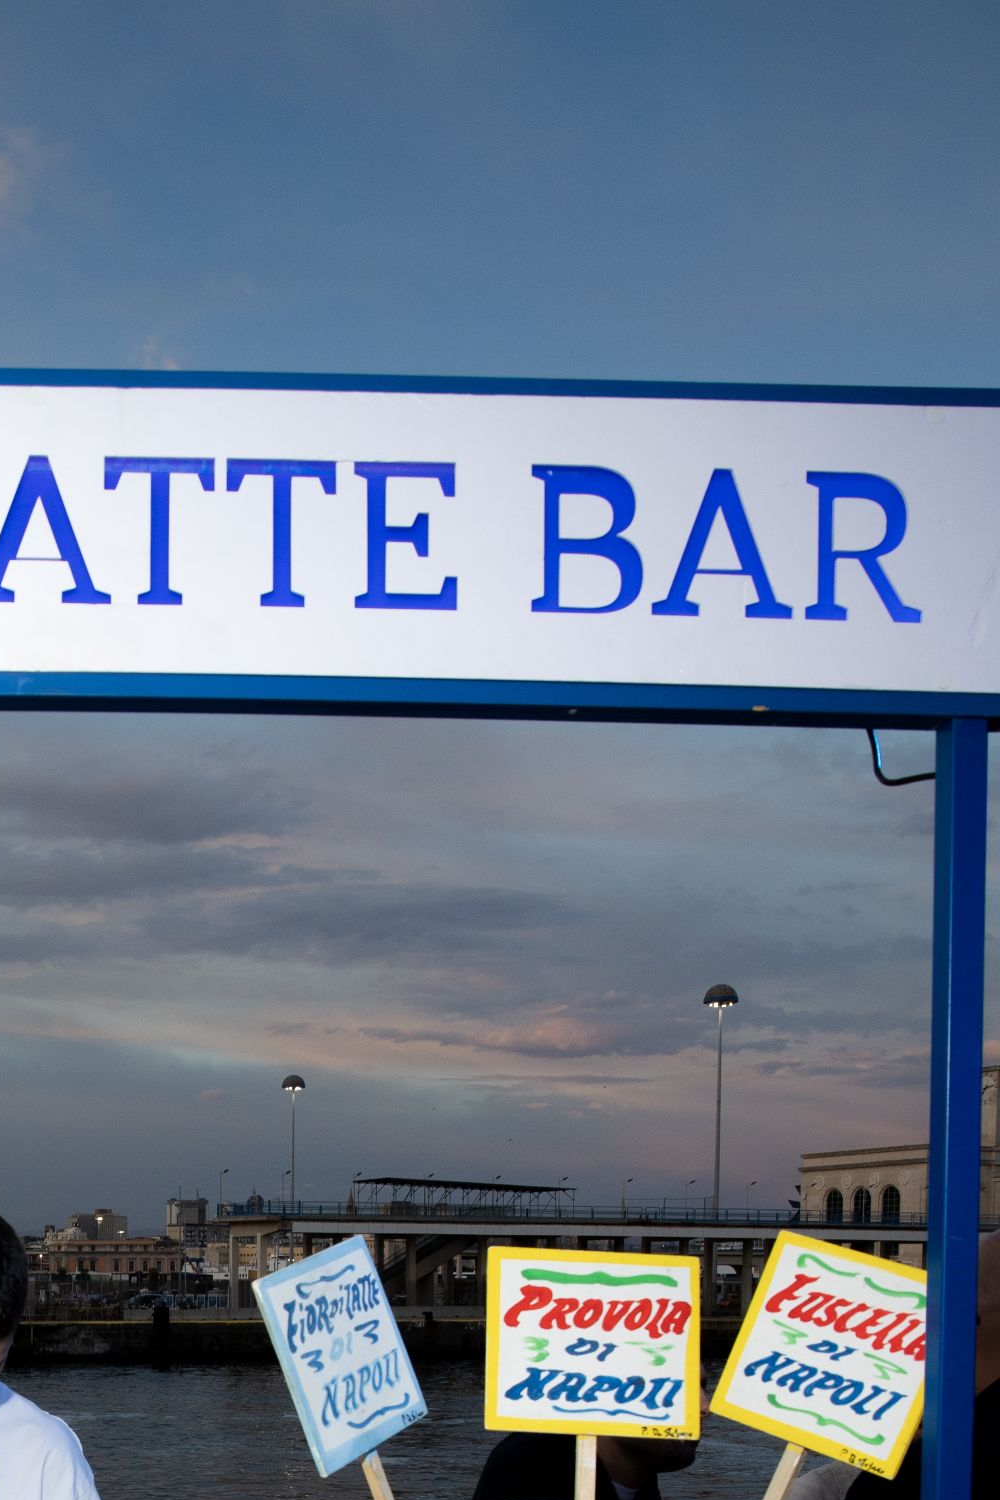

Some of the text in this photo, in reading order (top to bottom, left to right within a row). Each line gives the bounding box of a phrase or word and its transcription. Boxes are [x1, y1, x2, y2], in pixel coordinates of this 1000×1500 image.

[531, 463, 922, 623] BAR
[503, 1284, 692, 1339] PROVOLA
[329, 1331, 354, 1362] DI
[565, 1337, 619, 1362] DI
[806, 1339, 857, 1361] DI
[321, 1348, 401, 1427] NAPOLI
[504, 1367, 684, 1410] NAPOLI
[744, 1350, 909, 1421] NAPOLI
